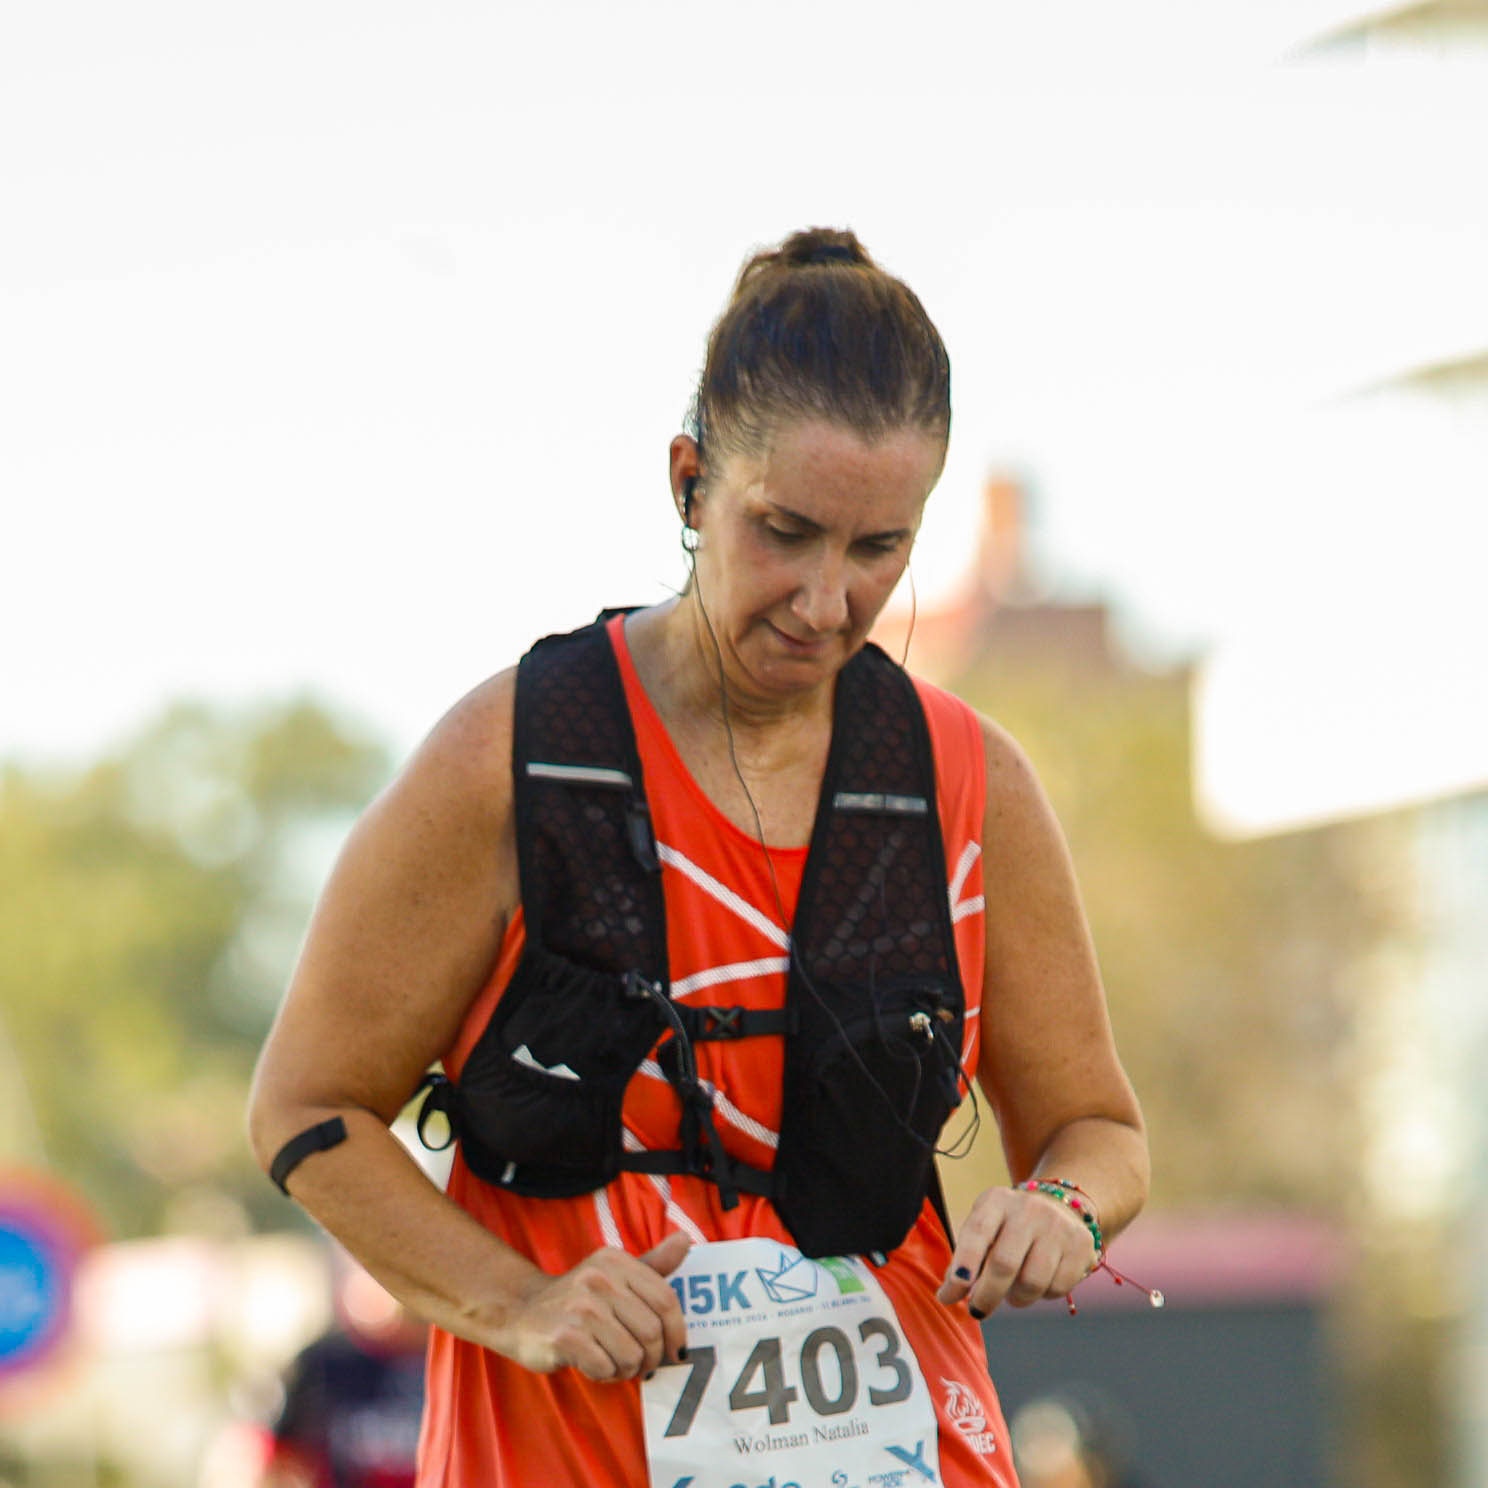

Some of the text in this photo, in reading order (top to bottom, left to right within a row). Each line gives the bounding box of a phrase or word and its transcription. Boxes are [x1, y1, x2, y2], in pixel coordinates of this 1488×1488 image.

[669, 1270, 752, 1315] 15K
[660, 1317, 912, 1438] 7403
[734, 1419, 870, 1454] Wolman Natalia
